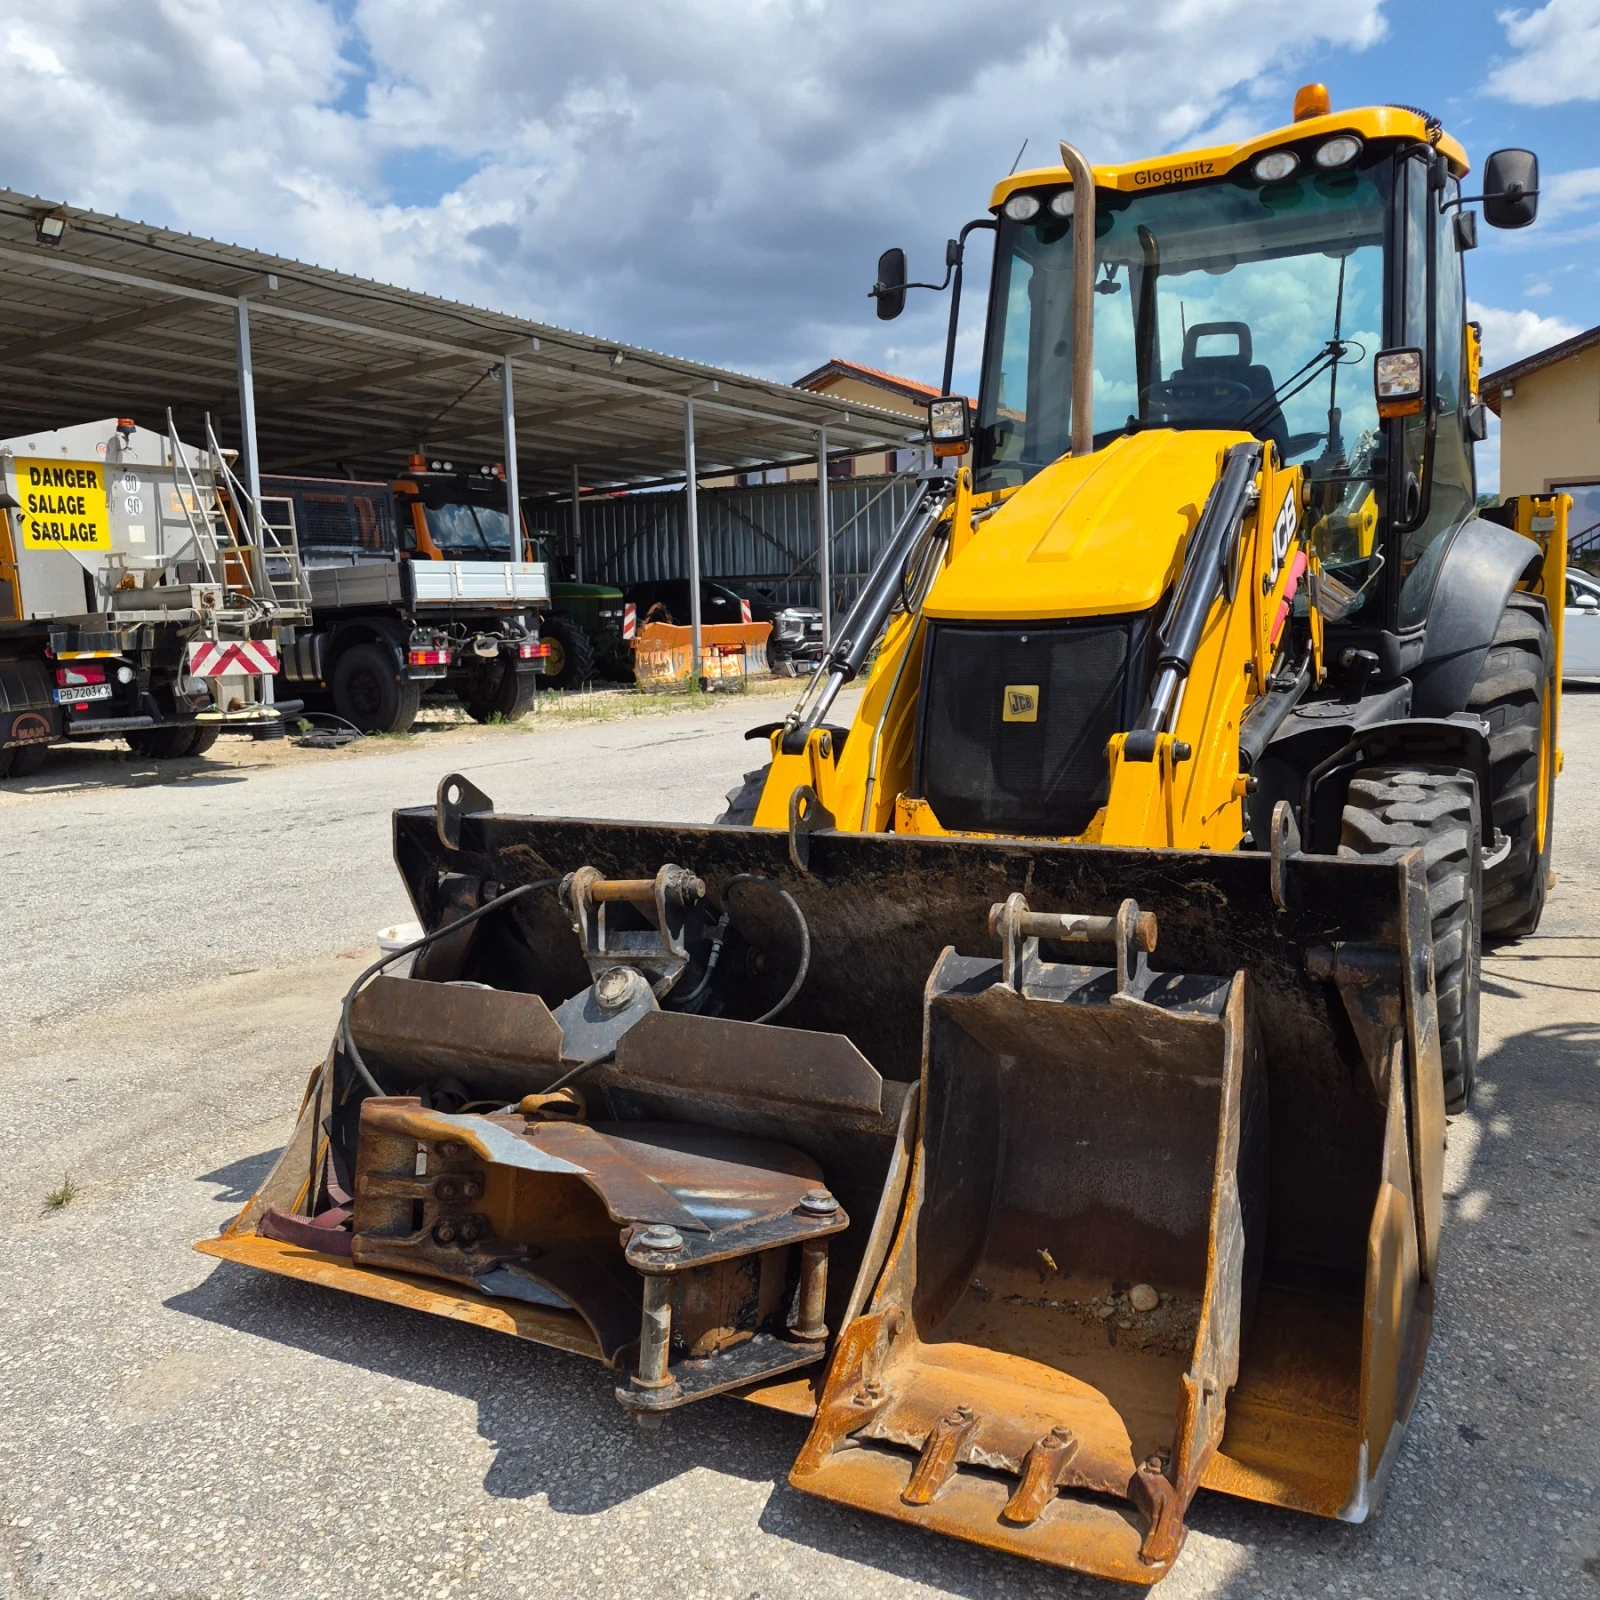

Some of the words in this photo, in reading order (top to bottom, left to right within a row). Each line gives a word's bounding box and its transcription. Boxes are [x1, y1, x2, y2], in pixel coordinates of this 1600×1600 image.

[1134, 162, 1214, 185] Gloggnitz
[29, 467, 97, 488] DANGER
[125, 475, 137, 492] 80
[28, 493, 86, 515] SALAGE
[127, 498, 140, 515] 90
[31, 521, 98, 542] SABLAGE
[1012, 694, 1032, 712] JCB
[18, 727, 45, 739] MAN
